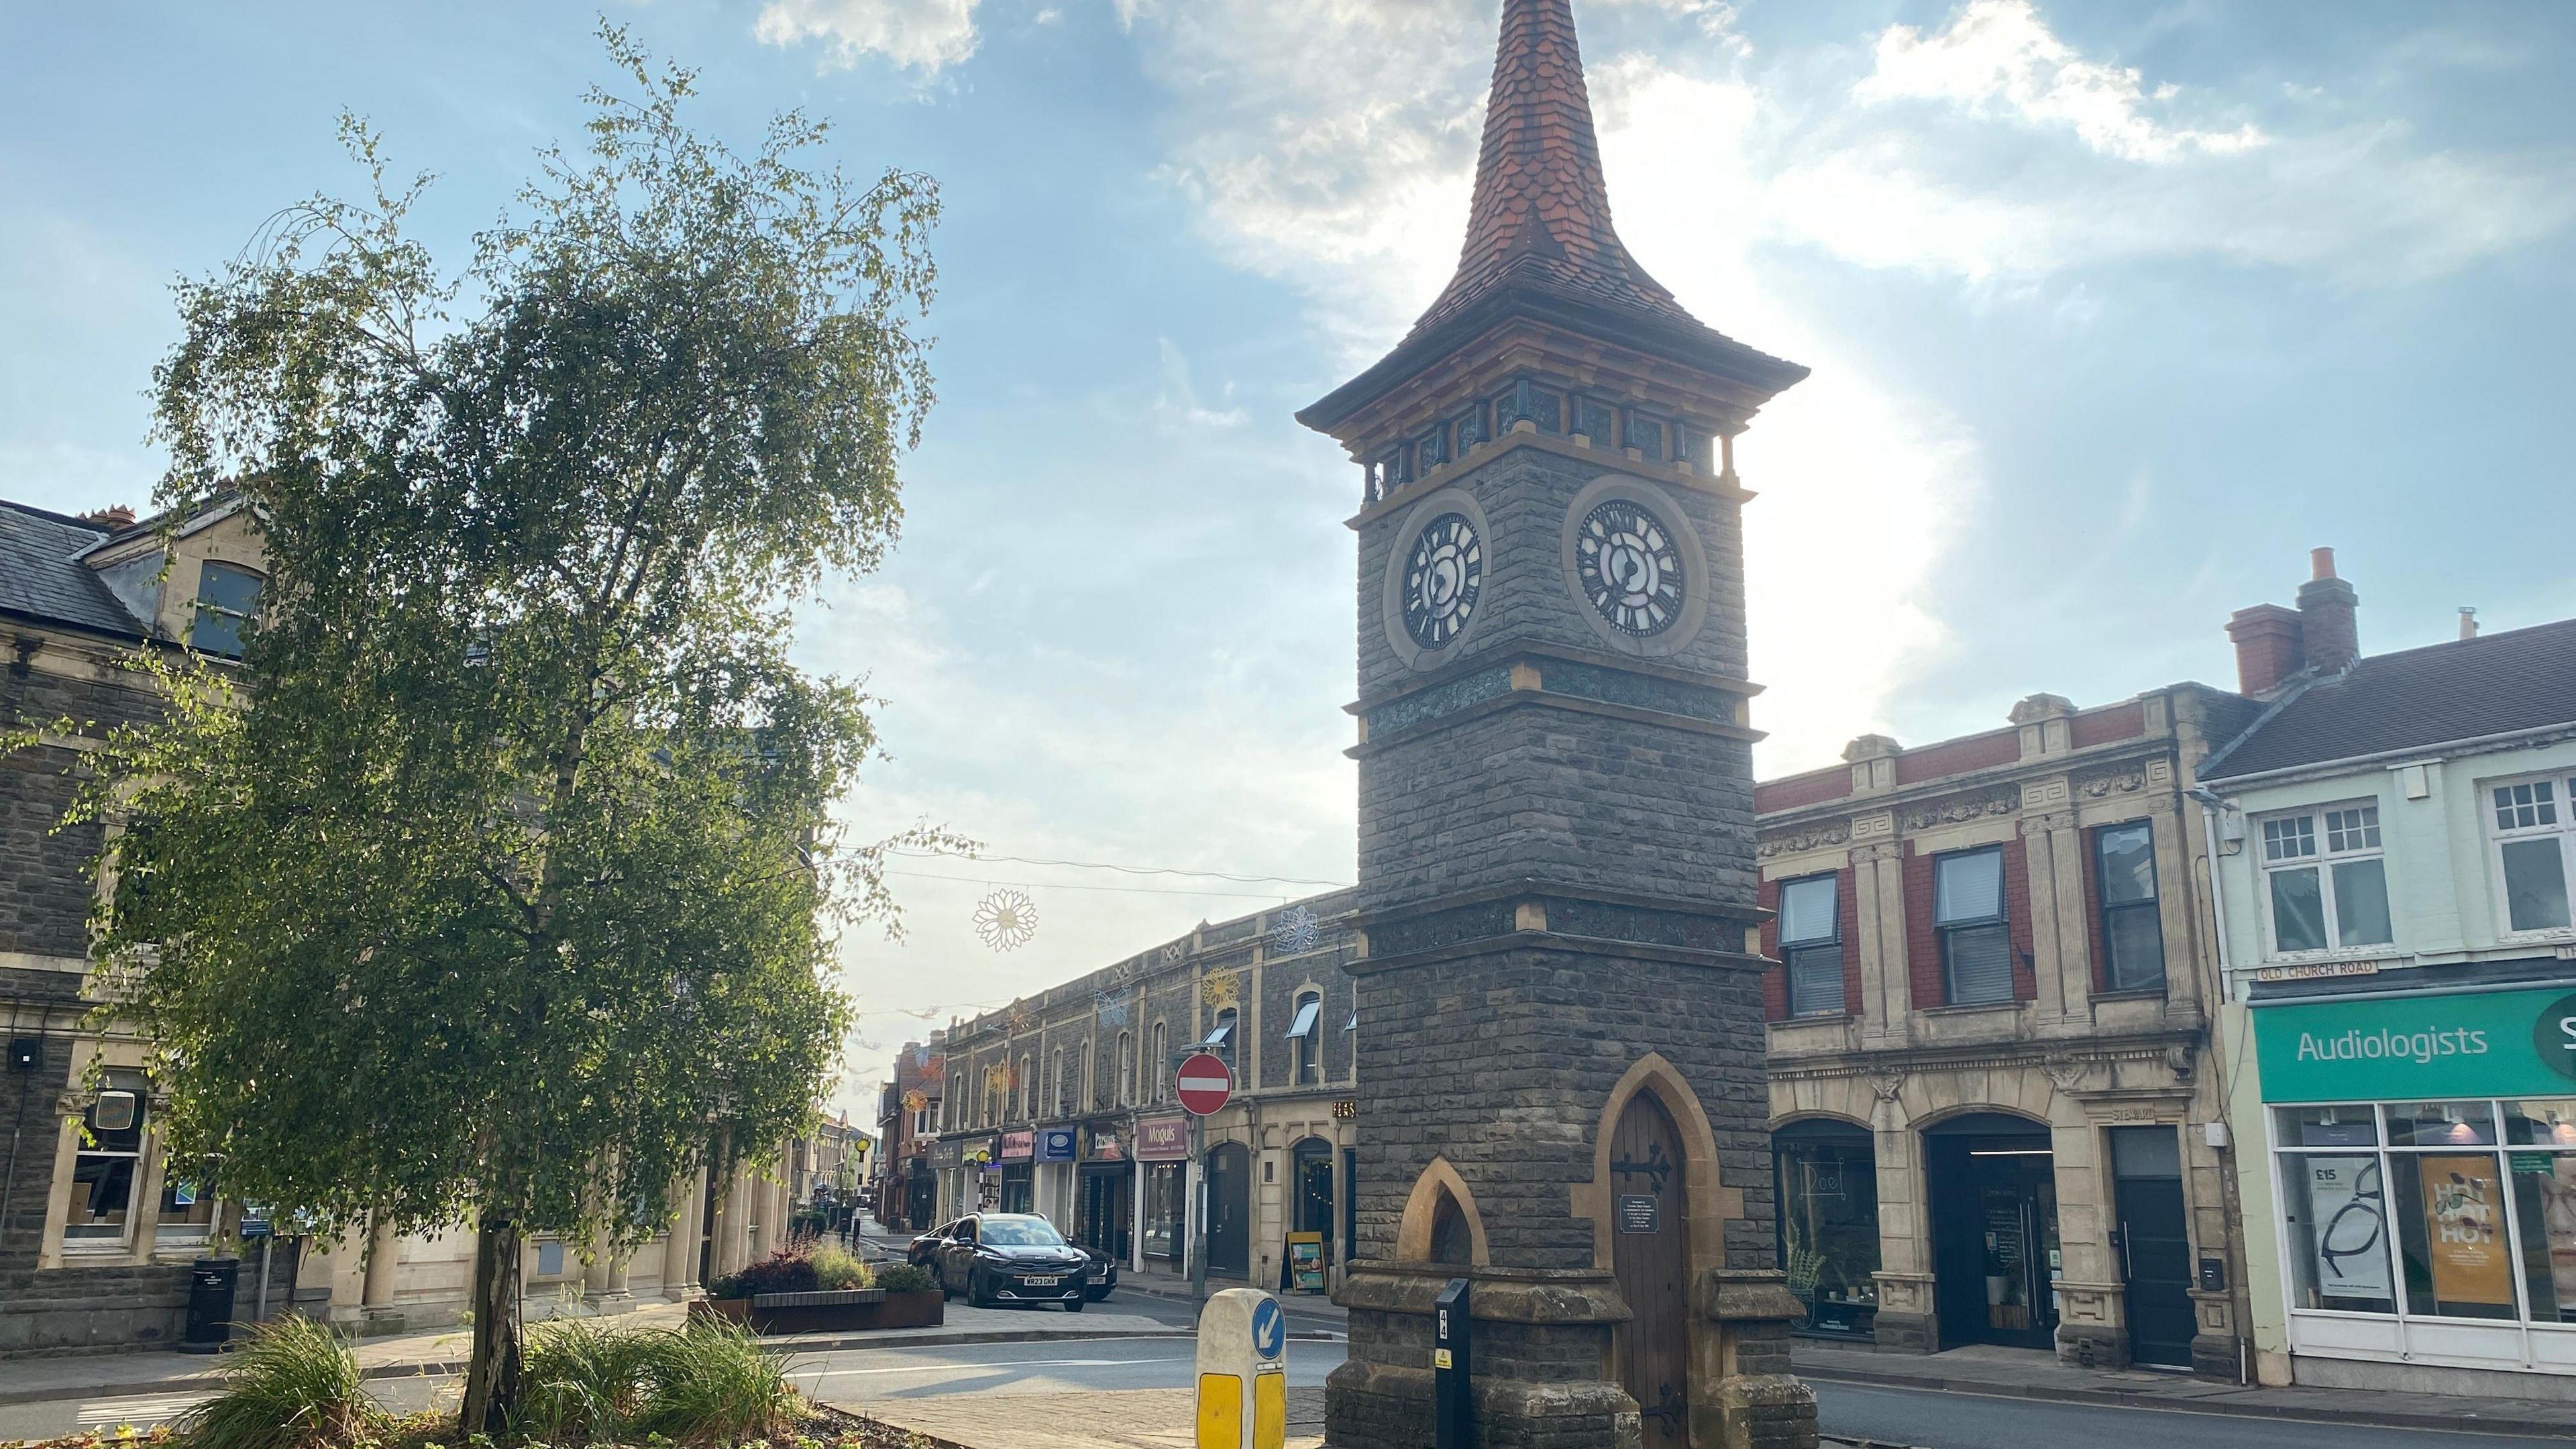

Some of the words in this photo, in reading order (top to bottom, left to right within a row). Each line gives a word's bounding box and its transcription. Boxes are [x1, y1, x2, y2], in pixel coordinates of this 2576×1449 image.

[2261, 968, 2282, 979] OLD
[2288, 964, 2334, 977] CHURCH
[2340, 961, 2372, 974] ROAD
[2297, 1025, 2488, 1064] Audiologists
[2112, 1108, 2157, 1121] STEWARD
[1148, 1124, 1175, 1145] Moguls
[2316, 1169, 2336, 1181] £15
